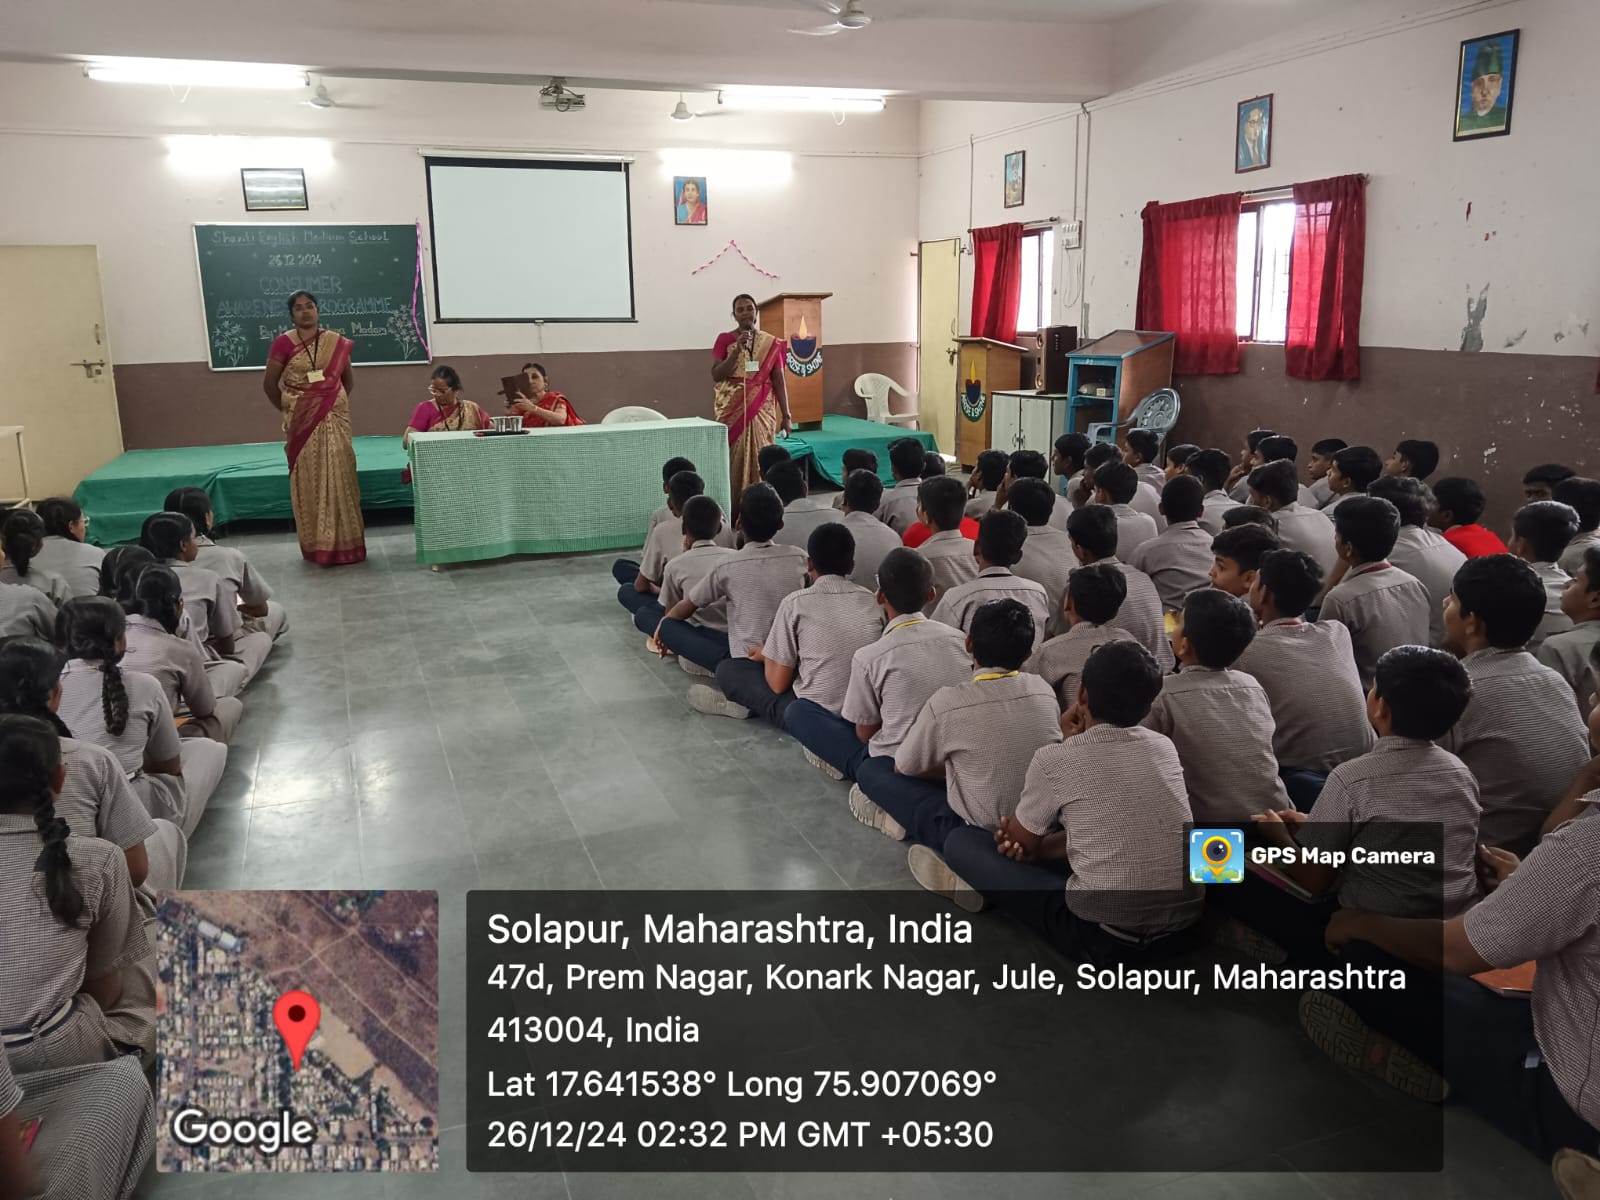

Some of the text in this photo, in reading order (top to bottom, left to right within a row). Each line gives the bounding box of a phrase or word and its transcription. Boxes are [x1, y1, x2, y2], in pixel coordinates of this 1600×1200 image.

[258, 230, 297, 247] English
[348, 230, 390, 241] School
[260, 275, 342, 293] CONSUMER
[319, 296, 392, 313] ROGRAMME
[351, 321, 387, 336] Madam
